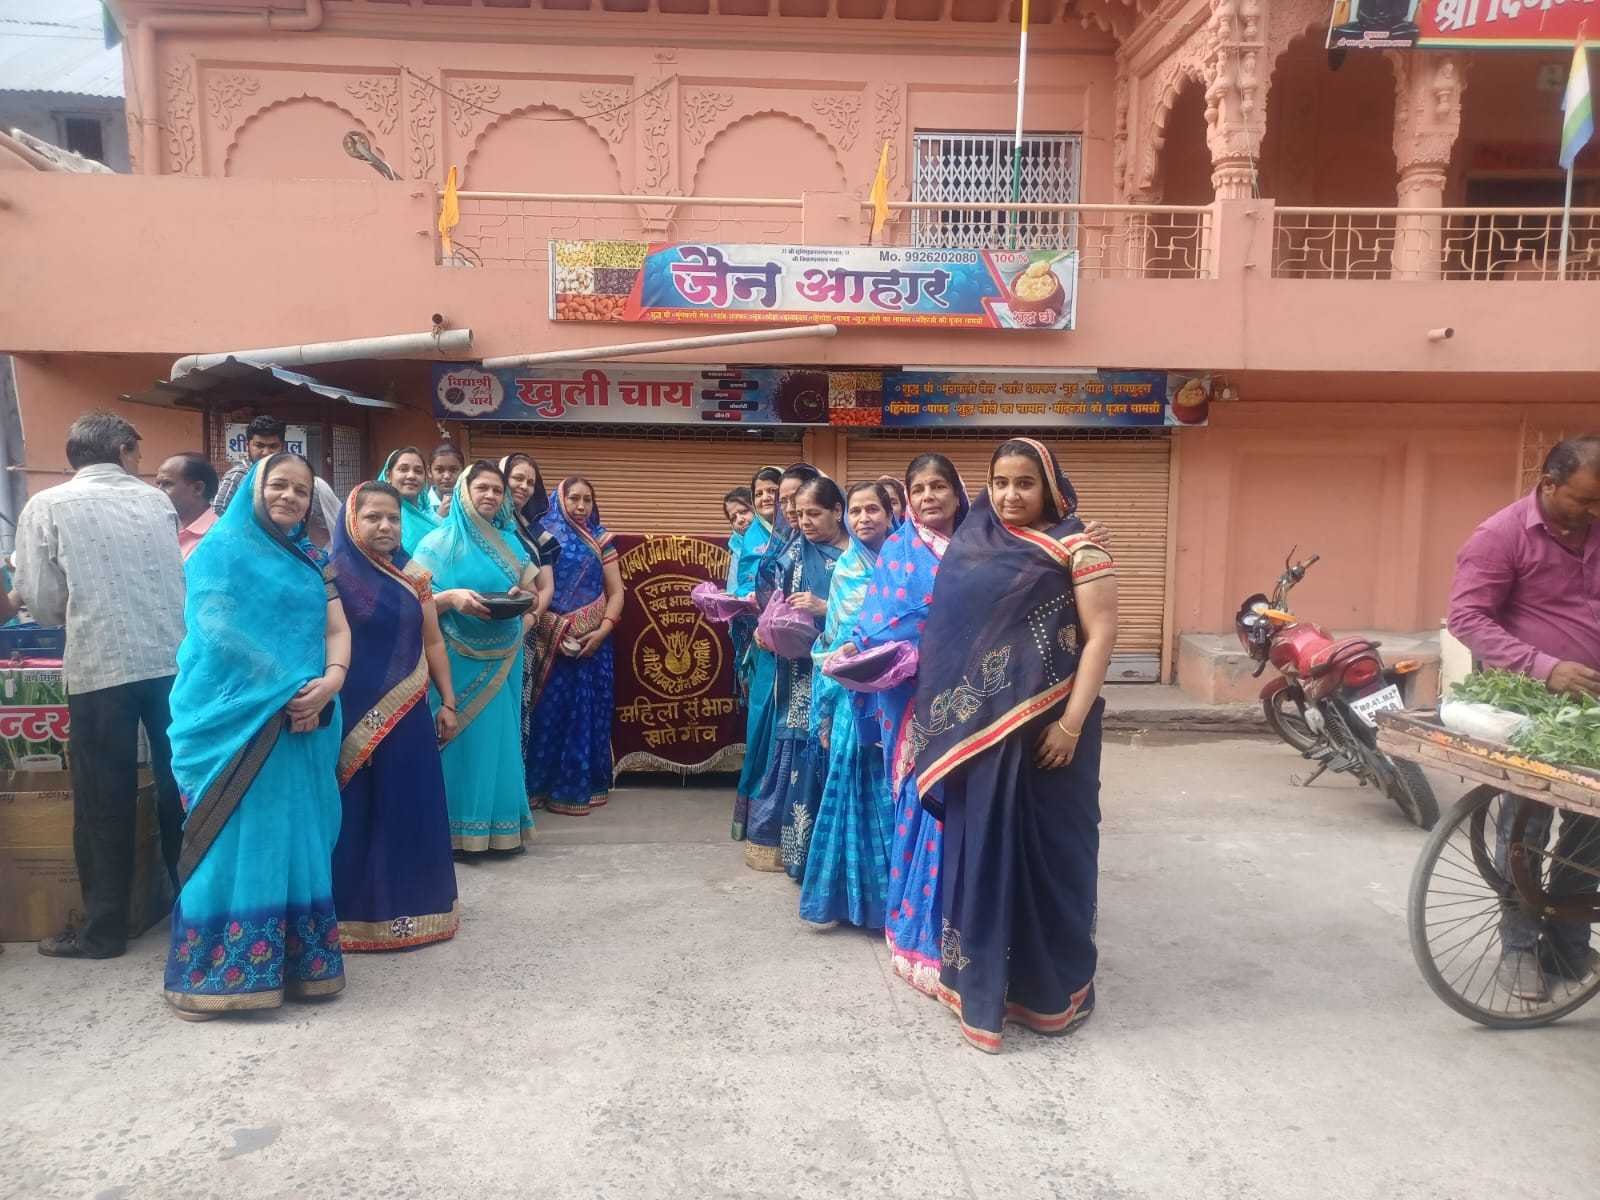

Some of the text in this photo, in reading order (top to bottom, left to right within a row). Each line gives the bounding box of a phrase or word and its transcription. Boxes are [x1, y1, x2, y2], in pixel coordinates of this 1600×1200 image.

[880, 250, 977, 264] Mo. 9926202080
[994, 254, 1015, 263] 100
[671, 245, 951, 311] जैन आहार
[515, 369, 695, 419] खुली चाय
[644, 582, 696, 598] समन्व
[616, 696, 679, 727] महिला
